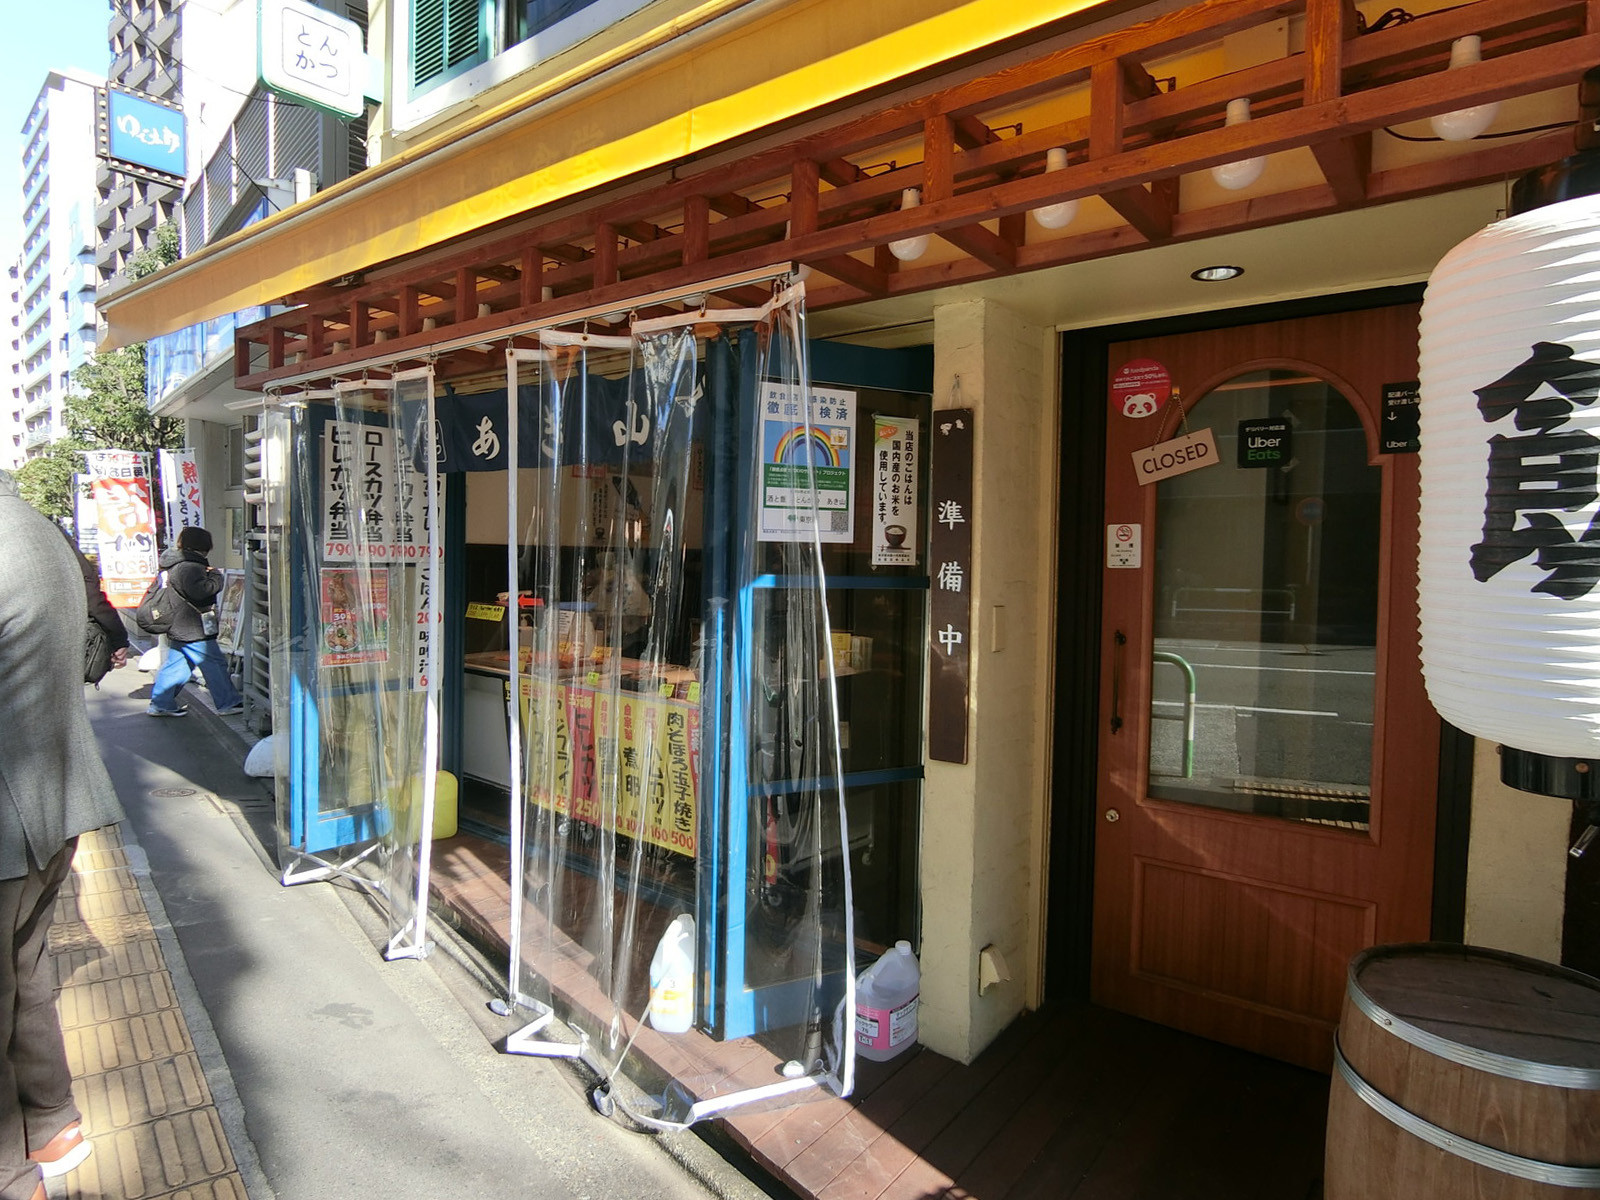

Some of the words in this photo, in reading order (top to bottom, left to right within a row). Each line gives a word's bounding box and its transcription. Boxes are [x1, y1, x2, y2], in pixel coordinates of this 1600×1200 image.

[297, 24, 338, 57] とん
[295, 49, 339, 79] かつ
[769, 391, 847, 406] 飲食店感染防止
[1248, 437, 1282, 449] Uber
[1248, 449, 1281, 461] Eats
[1386, 440, 1407, 448] Uber
[903, 430, 914, 506] 当店のごはんは
[1142, 442, 1209, 475] CLOSED
[364, 430, 383, 543] ロースカツ弁当
[891, 440, 902, 516] 国内産のお米を
[937, 499, 966, 657] 準備中
[576, 797, 600, 821] 250
[671, 832, 694, 850] 500
